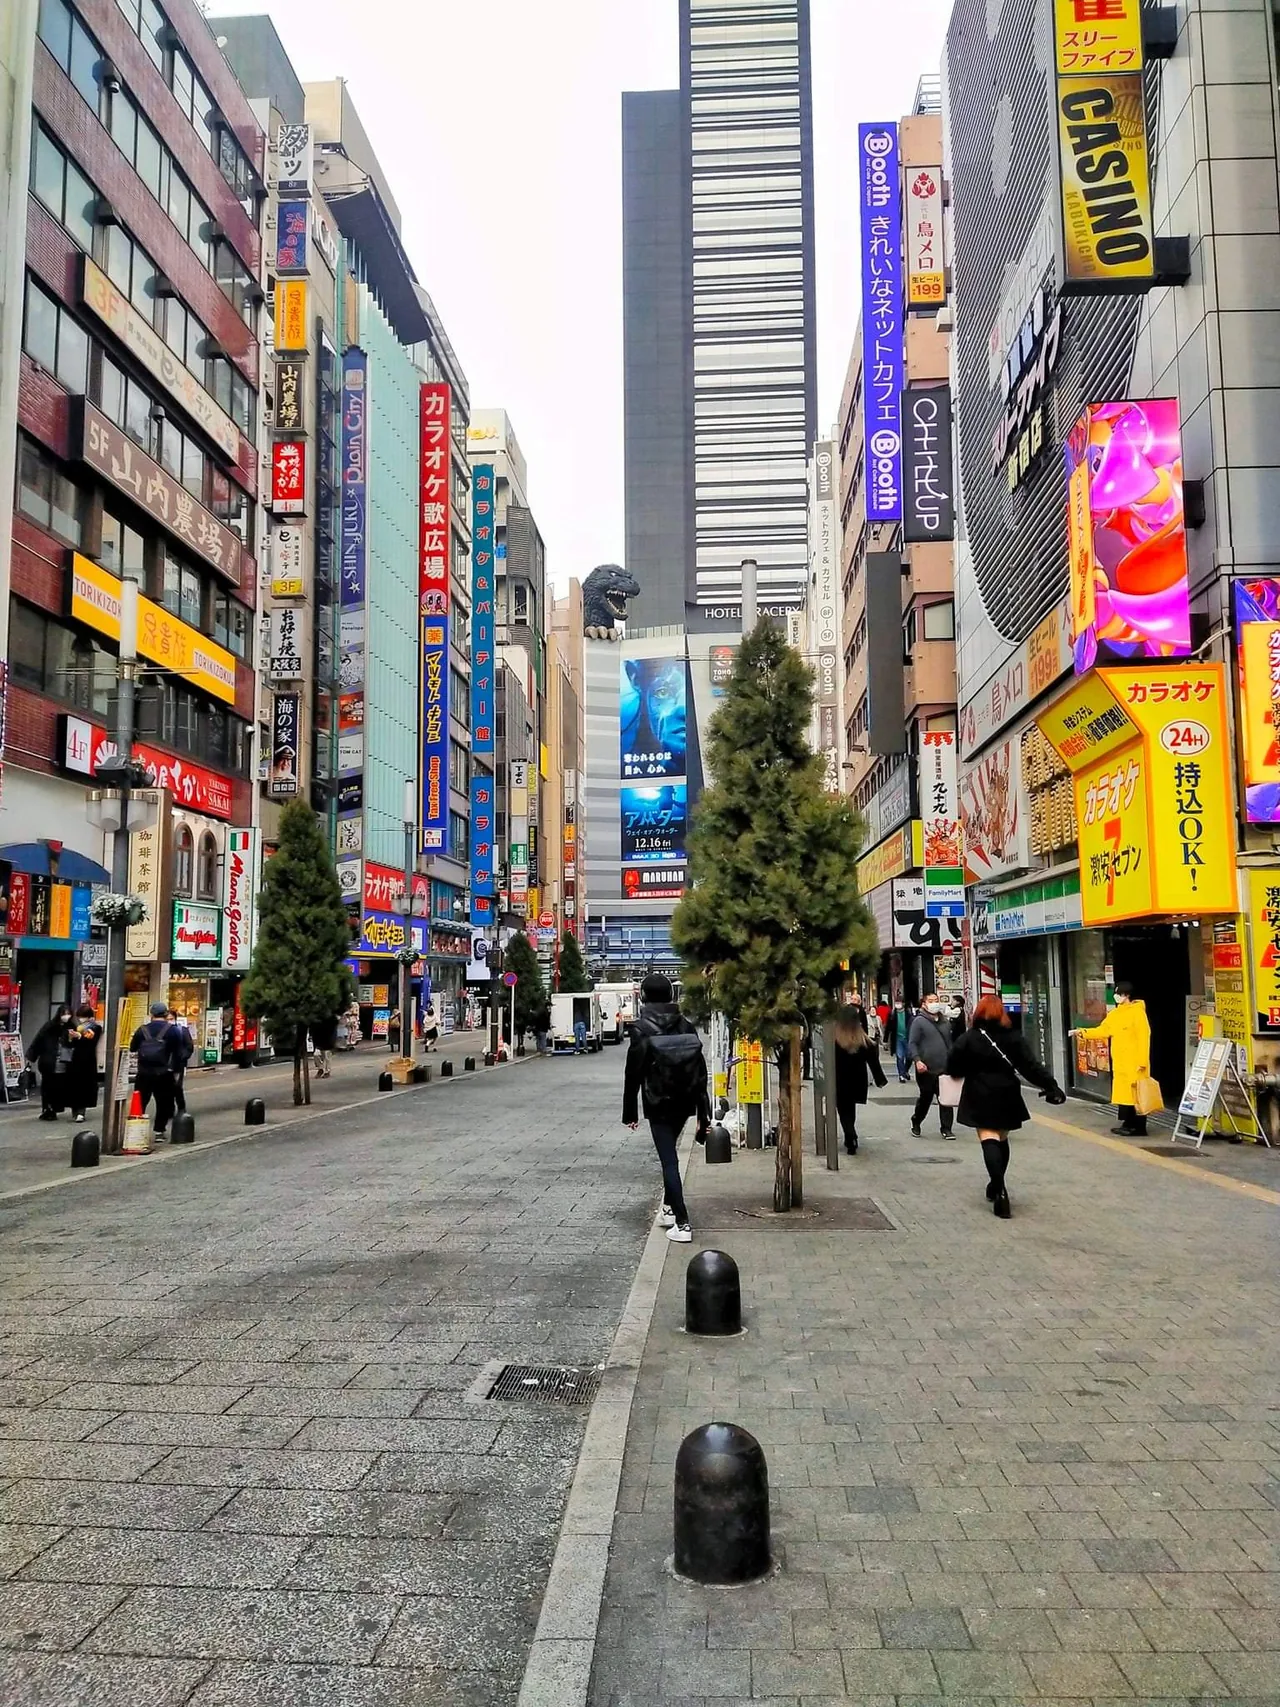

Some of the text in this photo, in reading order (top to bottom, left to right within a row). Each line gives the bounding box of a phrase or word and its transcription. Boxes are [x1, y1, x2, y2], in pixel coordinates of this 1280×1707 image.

[1062, 31, 1118, 48] スリー
[1062, 49, 1136, 69] ファイブ
[864, 131, 893, 207] Booth
[1061, 88, 1149, 267] CASINO
[917, 222, 934, 270] 鳥メロ
[1066, 191, 1095, 273] KABUKICHO
[95, 277, 119, 324] 3F
[912, 276, 940, 284] 生ビール
[915, 283, 941, 296] 199
[869, 215, 898, 421] きれいなネットカフェ
[281, 364, 298, 420] 山内農場
[90, 419, 109, 459] 5F
[422, 392, 447, 581] カラオケ歌広場
[817, 451, 833, 494] Booth
[871, 430, 900, 510] Booth
[112, 438, 223, 566] 山内農場
[280, 581, 296, 593] 3F
[705, 605, 801, 619] HOTEL RACERY
[820, 653, 836, 695] Booth
[991, 661, 1023, 726] 鳥メロ
[1127, 681, 1215, 704] カラオケ
[426, 651, 444, 744] マツモトキヨシ
[278, 700, 293, 744] 海の家
[1169, 727, 1203, 748] 24H
[68, 728, 90, 762] 4F
[428, 756, 440, 779] Shop
[208, 791, 230, 812] SAKAI
[932, 782, 948, 814] 九十九
[1083, 758, 1140, 828] カラオケ
[625, 809, 684, 828] アバター
[1174, 762, 1205, 892] 持込OK!
[137, 828, 153, 894] 珈琲茶館
[474, 789, 491, 911] カラオケ館
[635, 837, 672, 848] 12.16 fri
[1091, 843, 1141, 878] 激安セブン
[643, 870, 684, 883] MARUHAN
[928, 889, 962, 898] FamilyMart
[136, 941, 147, 950] 2F
